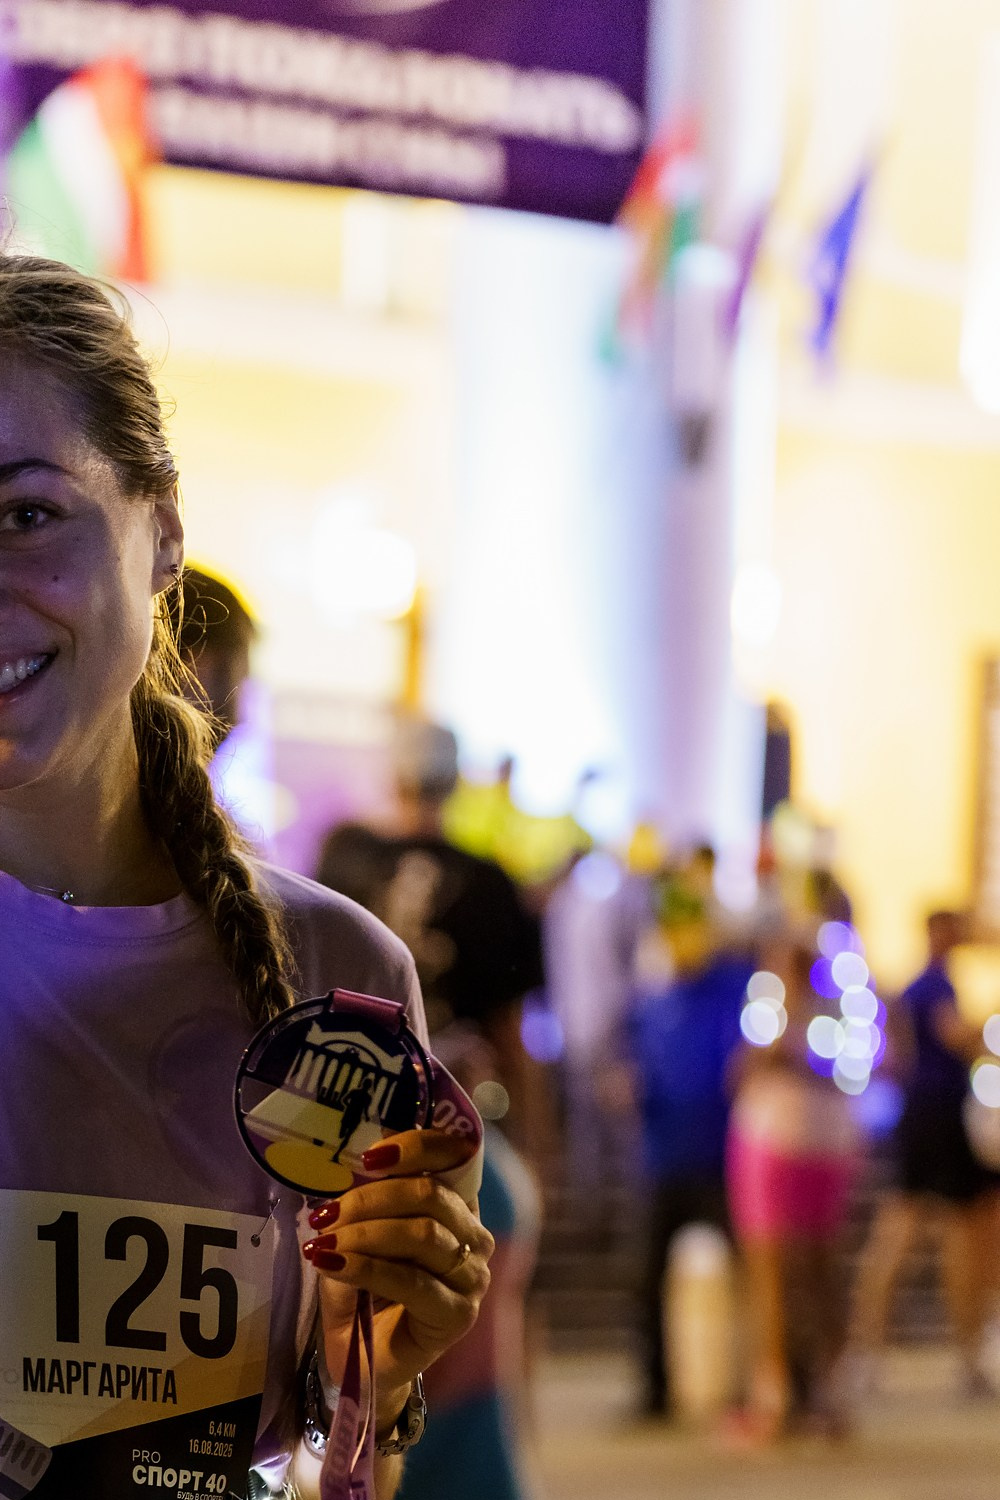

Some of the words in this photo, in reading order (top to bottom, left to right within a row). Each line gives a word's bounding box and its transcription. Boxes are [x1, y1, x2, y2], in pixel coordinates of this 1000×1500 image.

[36, 1210, 239, 1360] 125
[22, 1356, 178, 1405] МАРГАРИТА
[132, 1449, 161, 1463] PRO
[188, 1439, 234, 1458] 16.08.2025
[132, 1464, 204, 1491] СПОРТ
[205, 1473, 227, 1494] 40
[177, 1490, 195, 1500] БУДЬ
[195, 1493, 200, 1500] В
